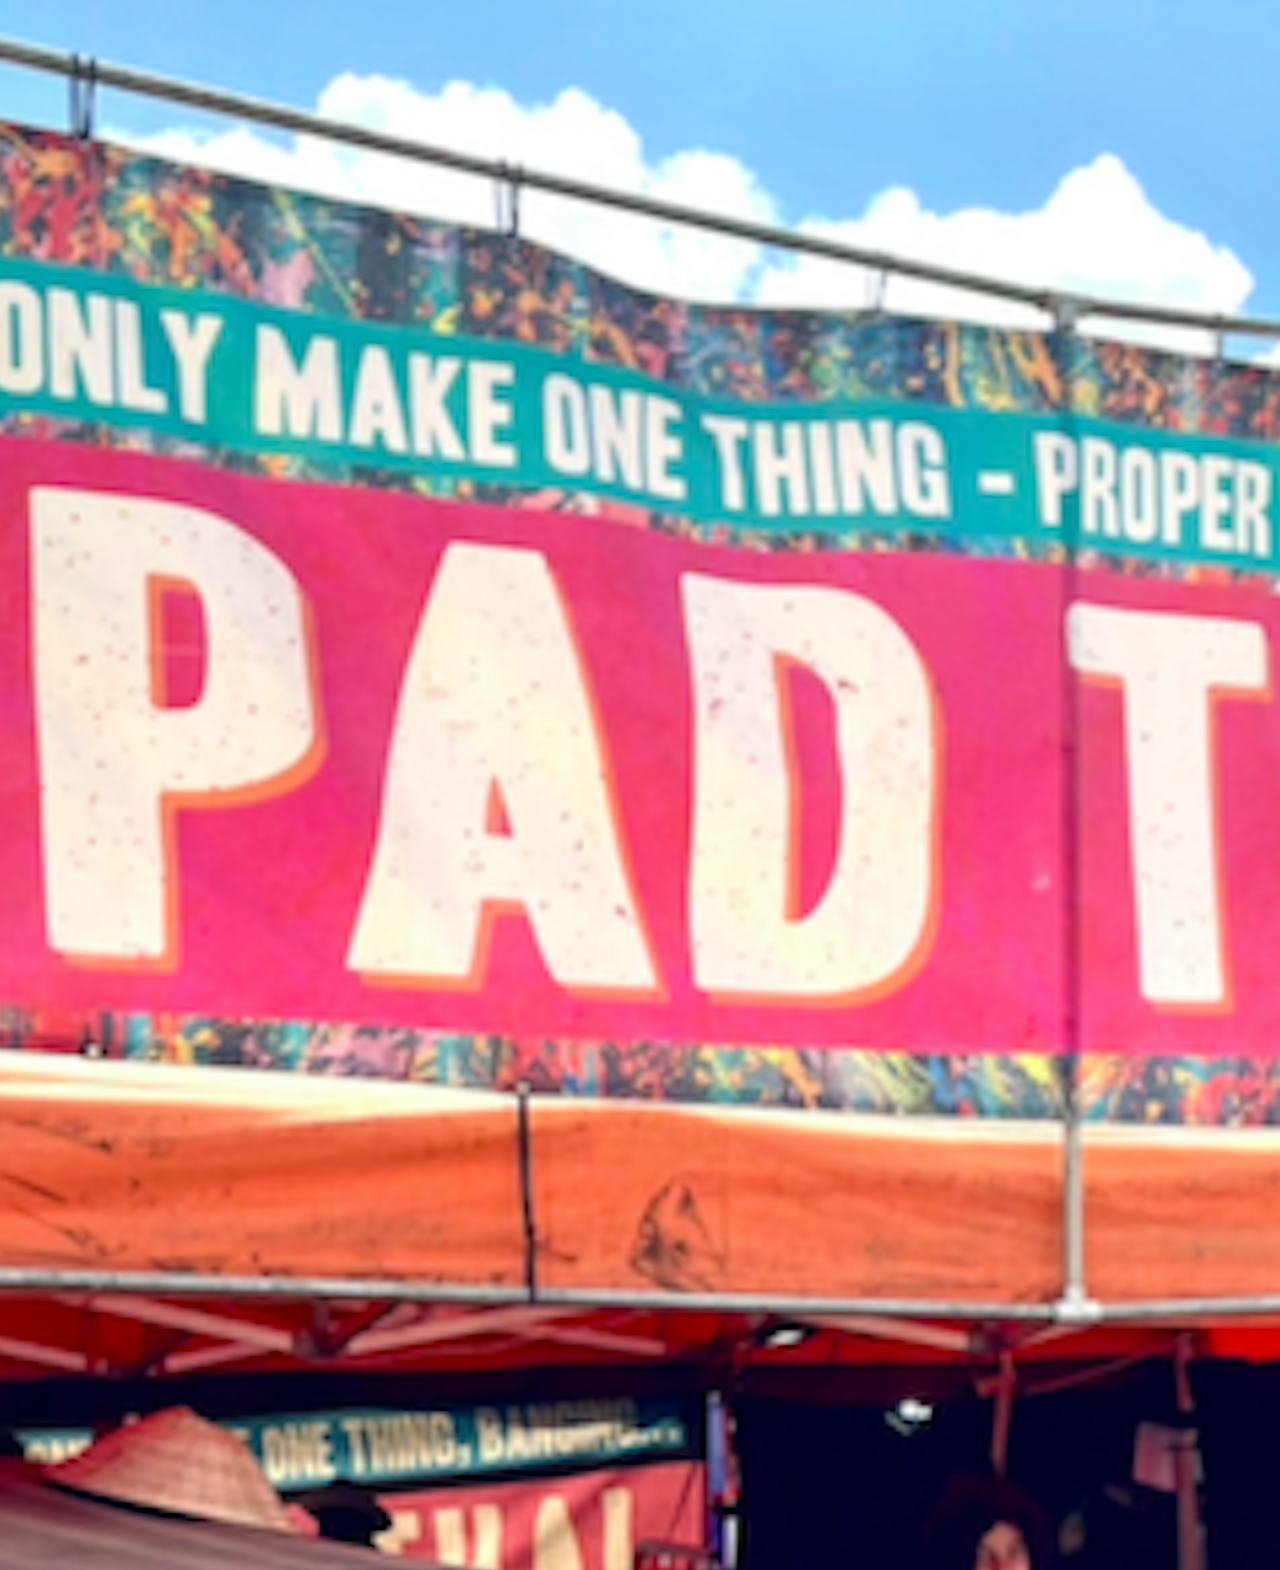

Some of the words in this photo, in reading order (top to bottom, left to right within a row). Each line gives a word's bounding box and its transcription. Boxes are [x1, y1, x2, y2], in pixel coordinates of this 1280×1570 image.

[254, 323, 517, 470] MAKE
[543, 373, 687, 499] ONE
[705, 416, 949, 519] THING
[980, 473, 1015, 495] -
[1037, 433, 1272, 558] PROPER
[28, 485, 942, 1002] PAD
[261, 1420, 337, 1484] ONE
